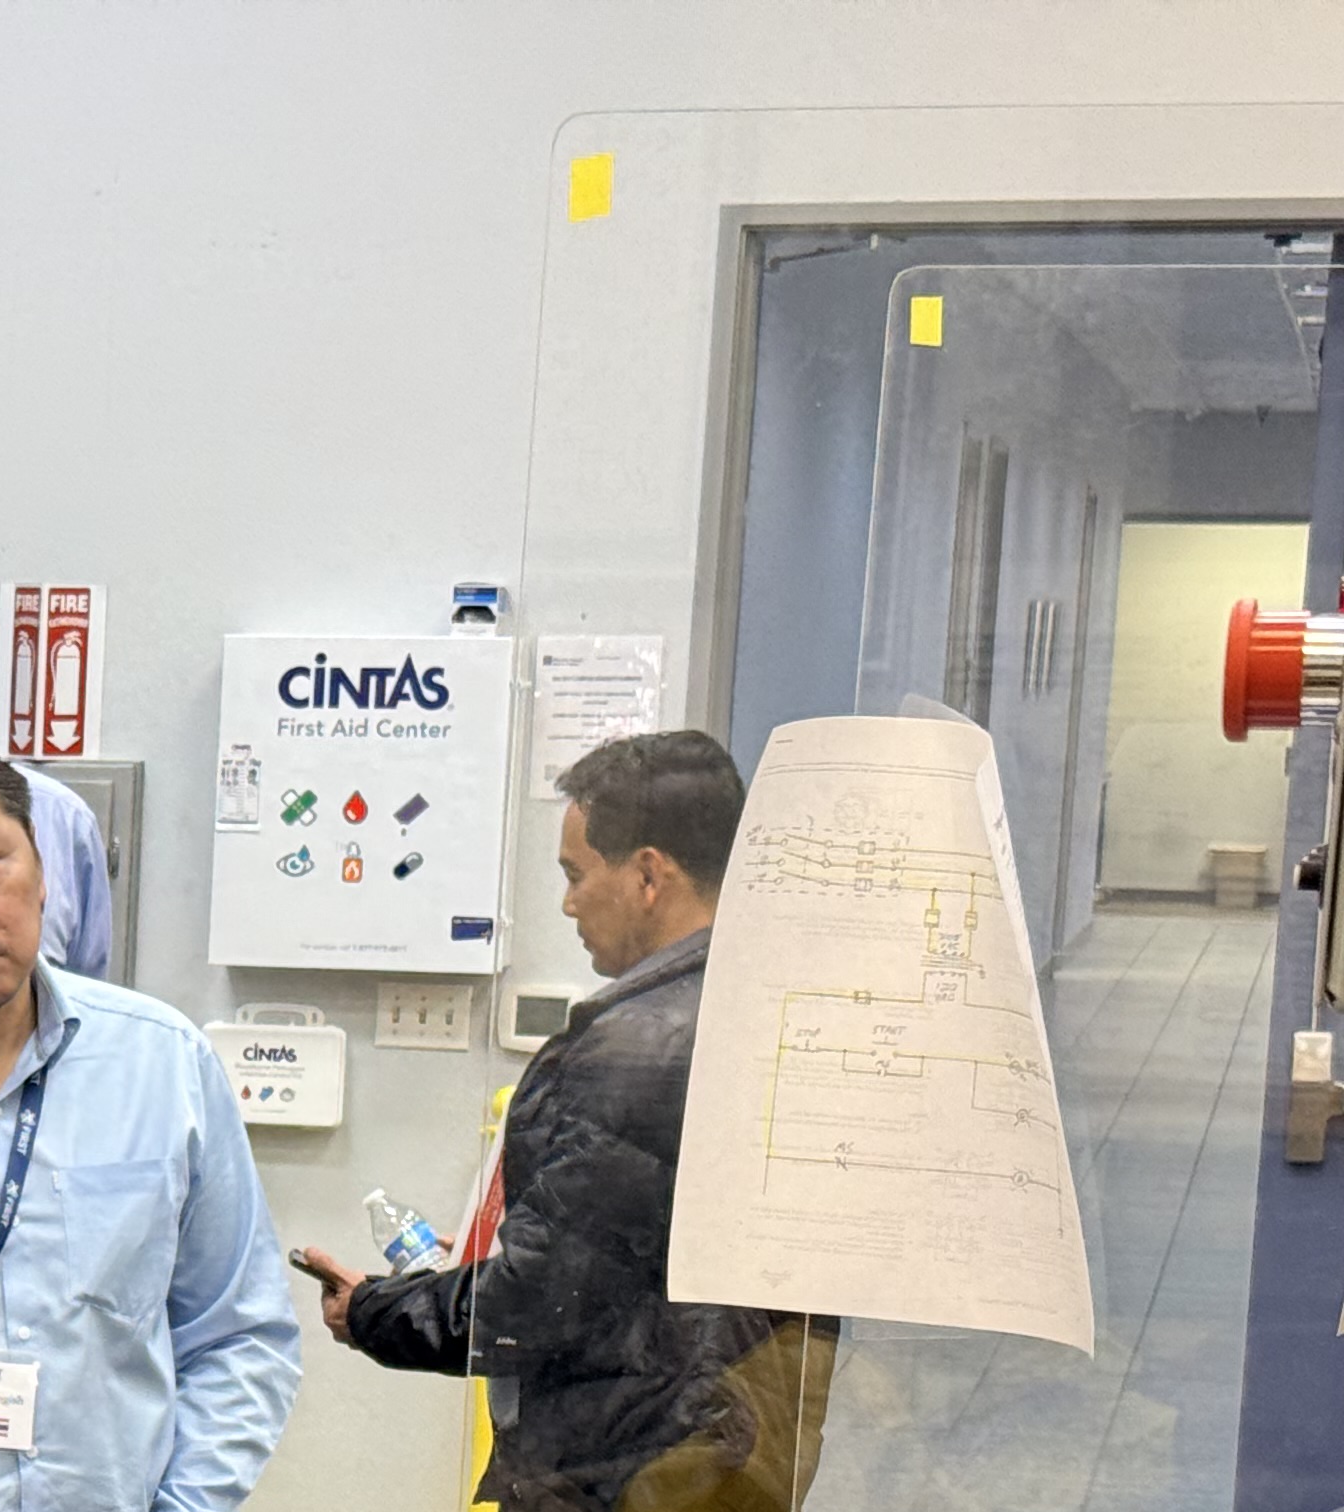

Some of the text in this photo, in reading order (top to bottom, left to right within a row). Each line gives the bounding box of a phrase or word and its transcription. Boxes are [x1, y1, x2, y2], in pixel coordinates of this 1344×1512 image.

[15, 593, 39, 612] FIRE
[50, 594, 88, 613] FIRE
[277, 718, 452, 739] First Aid Center
[872, 1025, 907, 1035] START
[16, 1126, 36, 1156] FIRST
